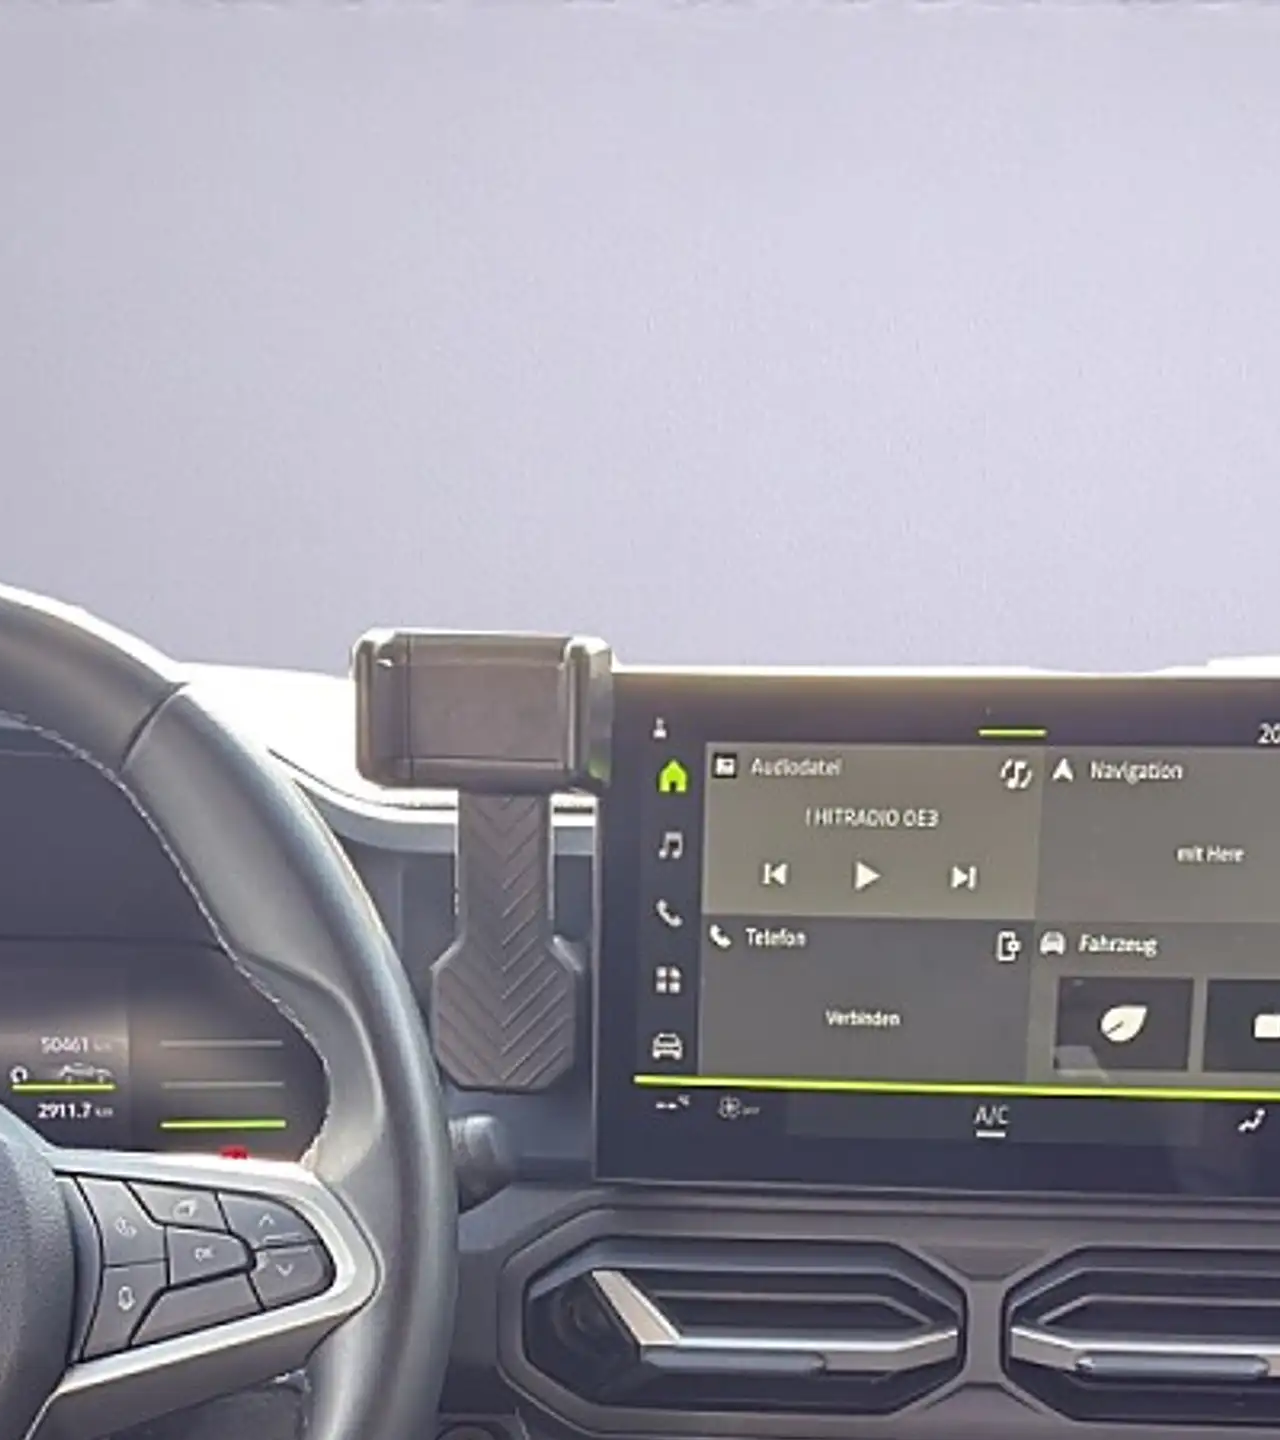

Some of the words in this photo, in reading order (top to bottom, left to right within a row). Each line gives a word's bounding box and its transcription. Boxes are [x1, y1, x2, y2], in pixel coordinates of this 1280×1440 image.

[751, 757, 843, 776] Audiodatei
[1090, 760, 1184, 784] Navigation
[1176, 845, 1204, 863] mit
[1206, 845, 1246, 864] Here
[746, 927, 807, 947] Telefon
[1078, 933, 1158, 958] Fahrzeug
[825, 1008, 901, 1028] Verbinden
[37, 1101, 93, 1119] 2911.7
[973, 1105, 1010, 1126] A/C
